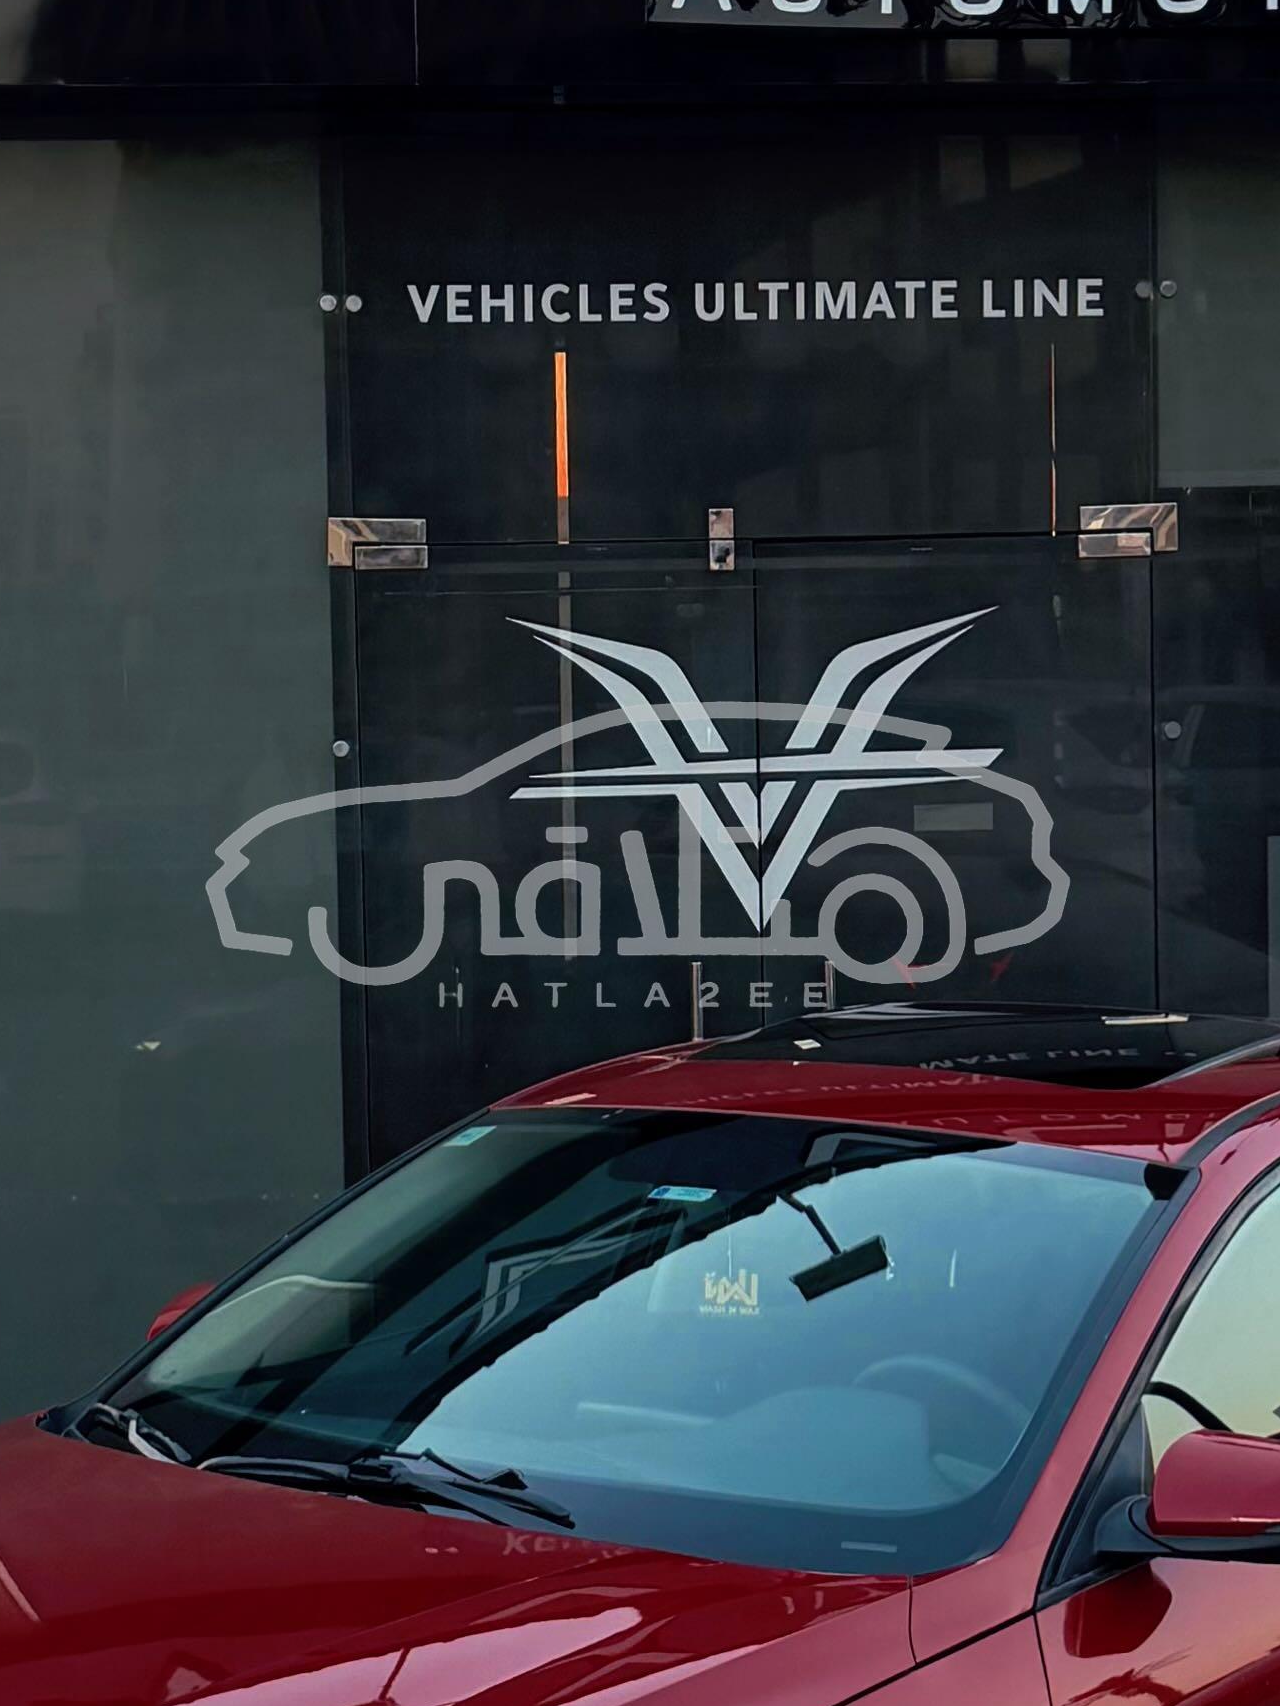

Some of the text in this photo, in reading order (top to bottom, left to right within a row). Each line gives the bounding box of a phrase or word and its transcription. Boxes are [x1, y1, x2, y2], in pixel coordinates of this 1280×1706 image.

[406, 278, 1104, 323] VEHICLES ULTIMATE LINE
